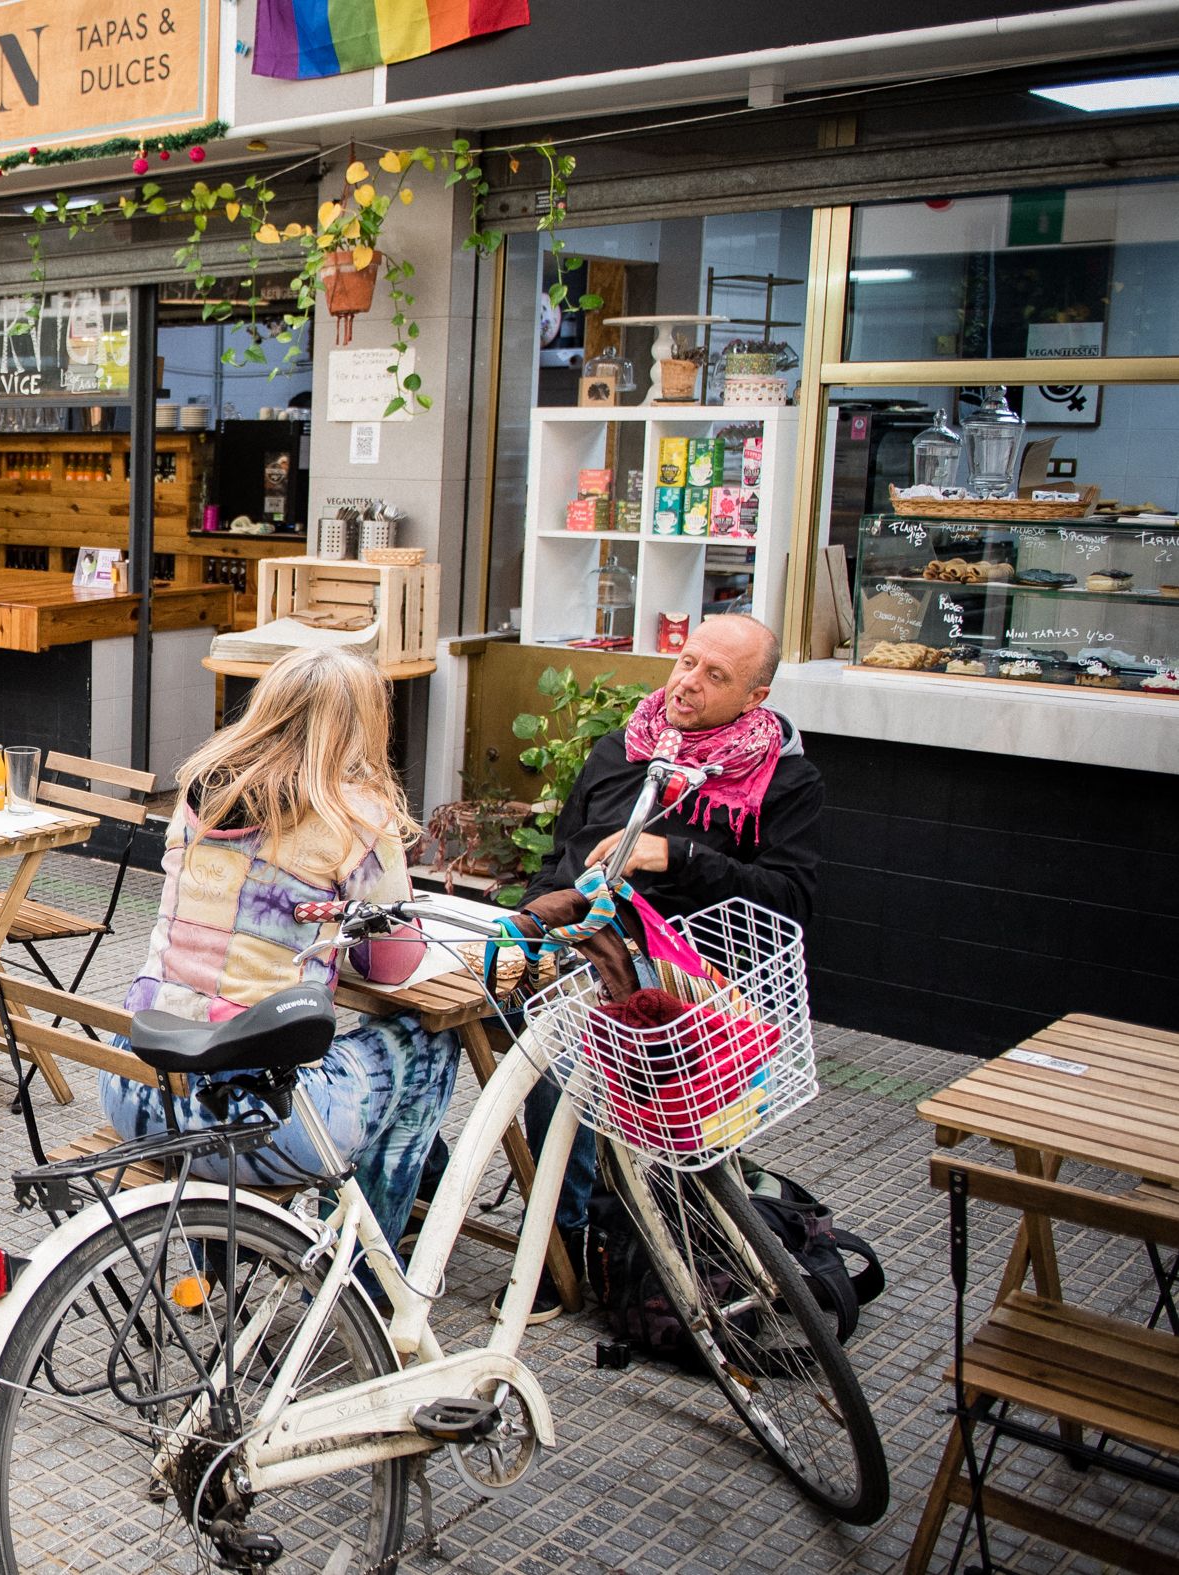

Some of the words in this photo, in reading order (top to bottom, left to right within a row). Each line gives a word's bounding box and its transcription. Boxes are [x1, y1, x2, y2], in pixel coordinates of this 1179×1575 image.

[77, 11, 149, 51] TAPAS
[157, 7, 176, 35] &
[81, 54, 171, 95] DULCES
[1075, 544, 1101, 554] 3'50
[1005, 628, 1028, 640] MINI
[1031, 628, 1080, 639] TARTAS
[1086, 629, 1115, 644] 4'50
[276, 998, 318, 1014] Sitzwohl.de
